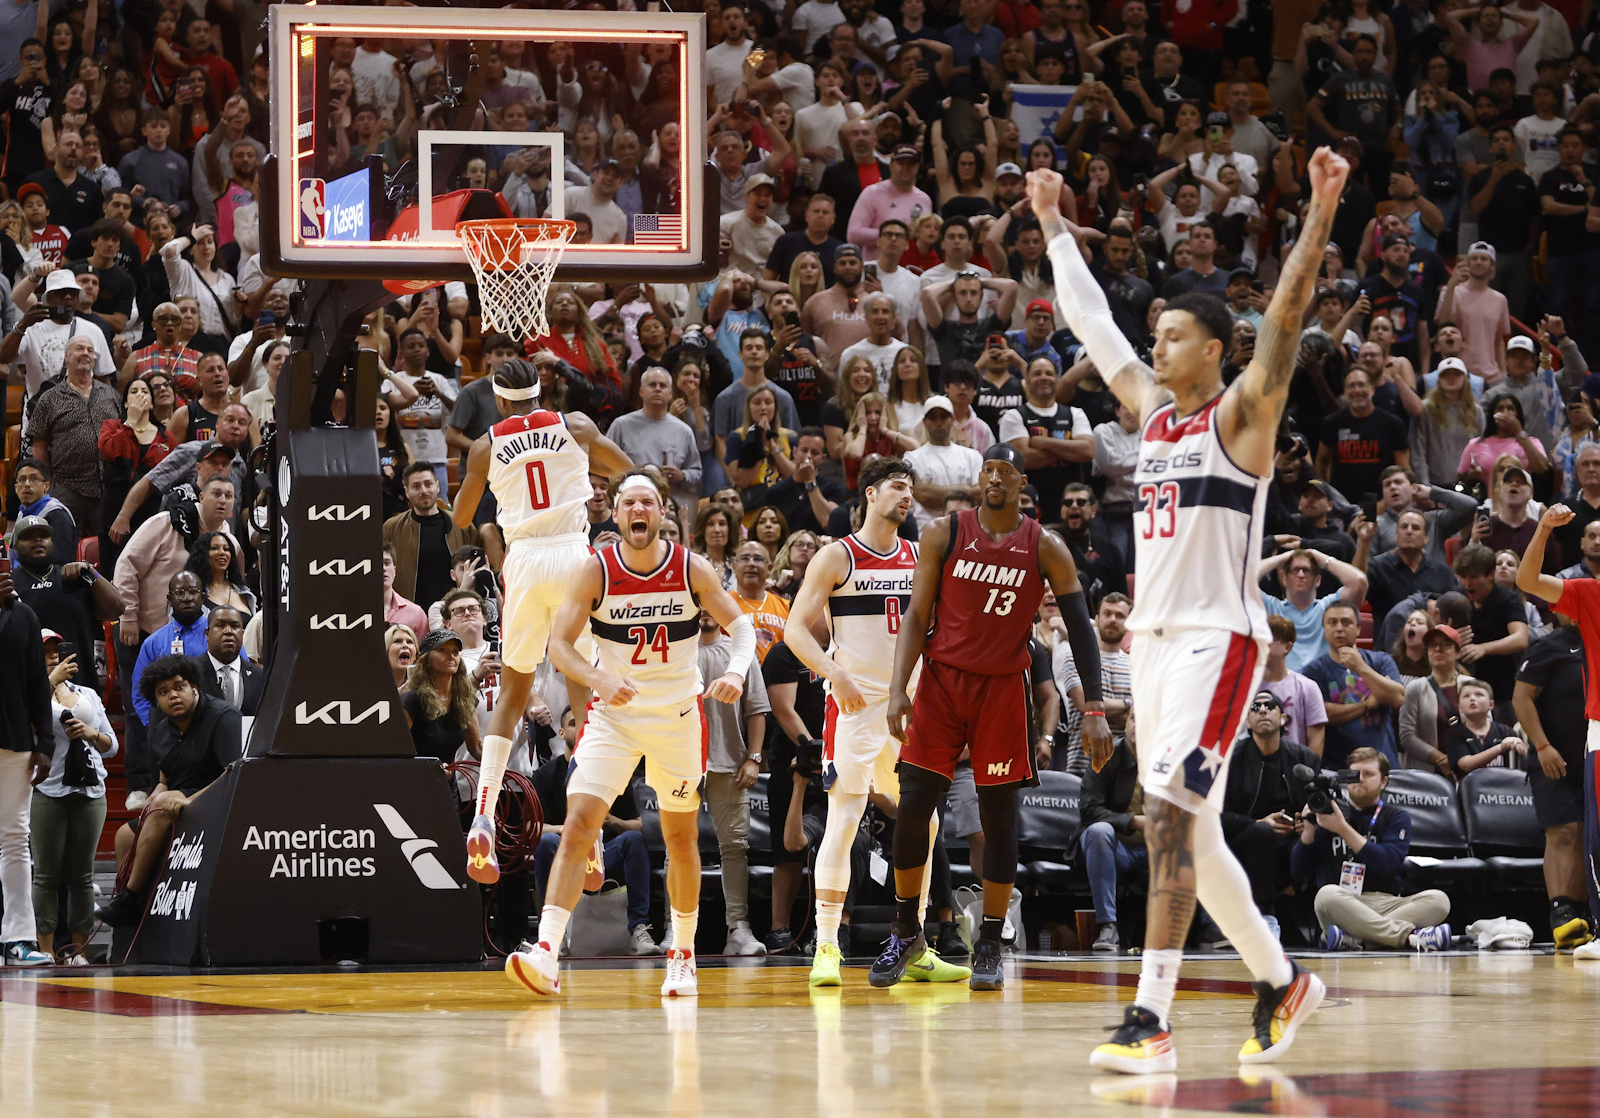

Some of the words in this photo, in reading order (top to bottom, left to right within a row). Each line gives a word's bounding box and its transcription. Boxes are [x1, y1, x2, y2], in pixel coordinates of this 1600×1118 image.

[303, 225, 317, 238] NBA
[333, 202, 364, 238] Kaseya
[978, 395, 1023, 407] MIAMI
[496, 432, 567, 465] COULIBALY
[525, 460, 551, 511] 0
[1139, 481, 1181, 540] 33
[280, 515, 290, 612] AT&T
[951, 558, 1027, 588] MIAMI
[610, 602, 684, 620] wizards
[885, 596, 901, 634] 8
[982, 588, 1018, 617] 13
[628, 624, 671, 665] 24
[1386, 793, 1449, 806] AMERANT
[1479, 793, 1534, 806] AMERAN
[168, 830, 205, 870] Florida
[242, 823, 376, 851] American
[269, 852, 377, 878] Airlines
[150, 876, 176, 916] Blue
